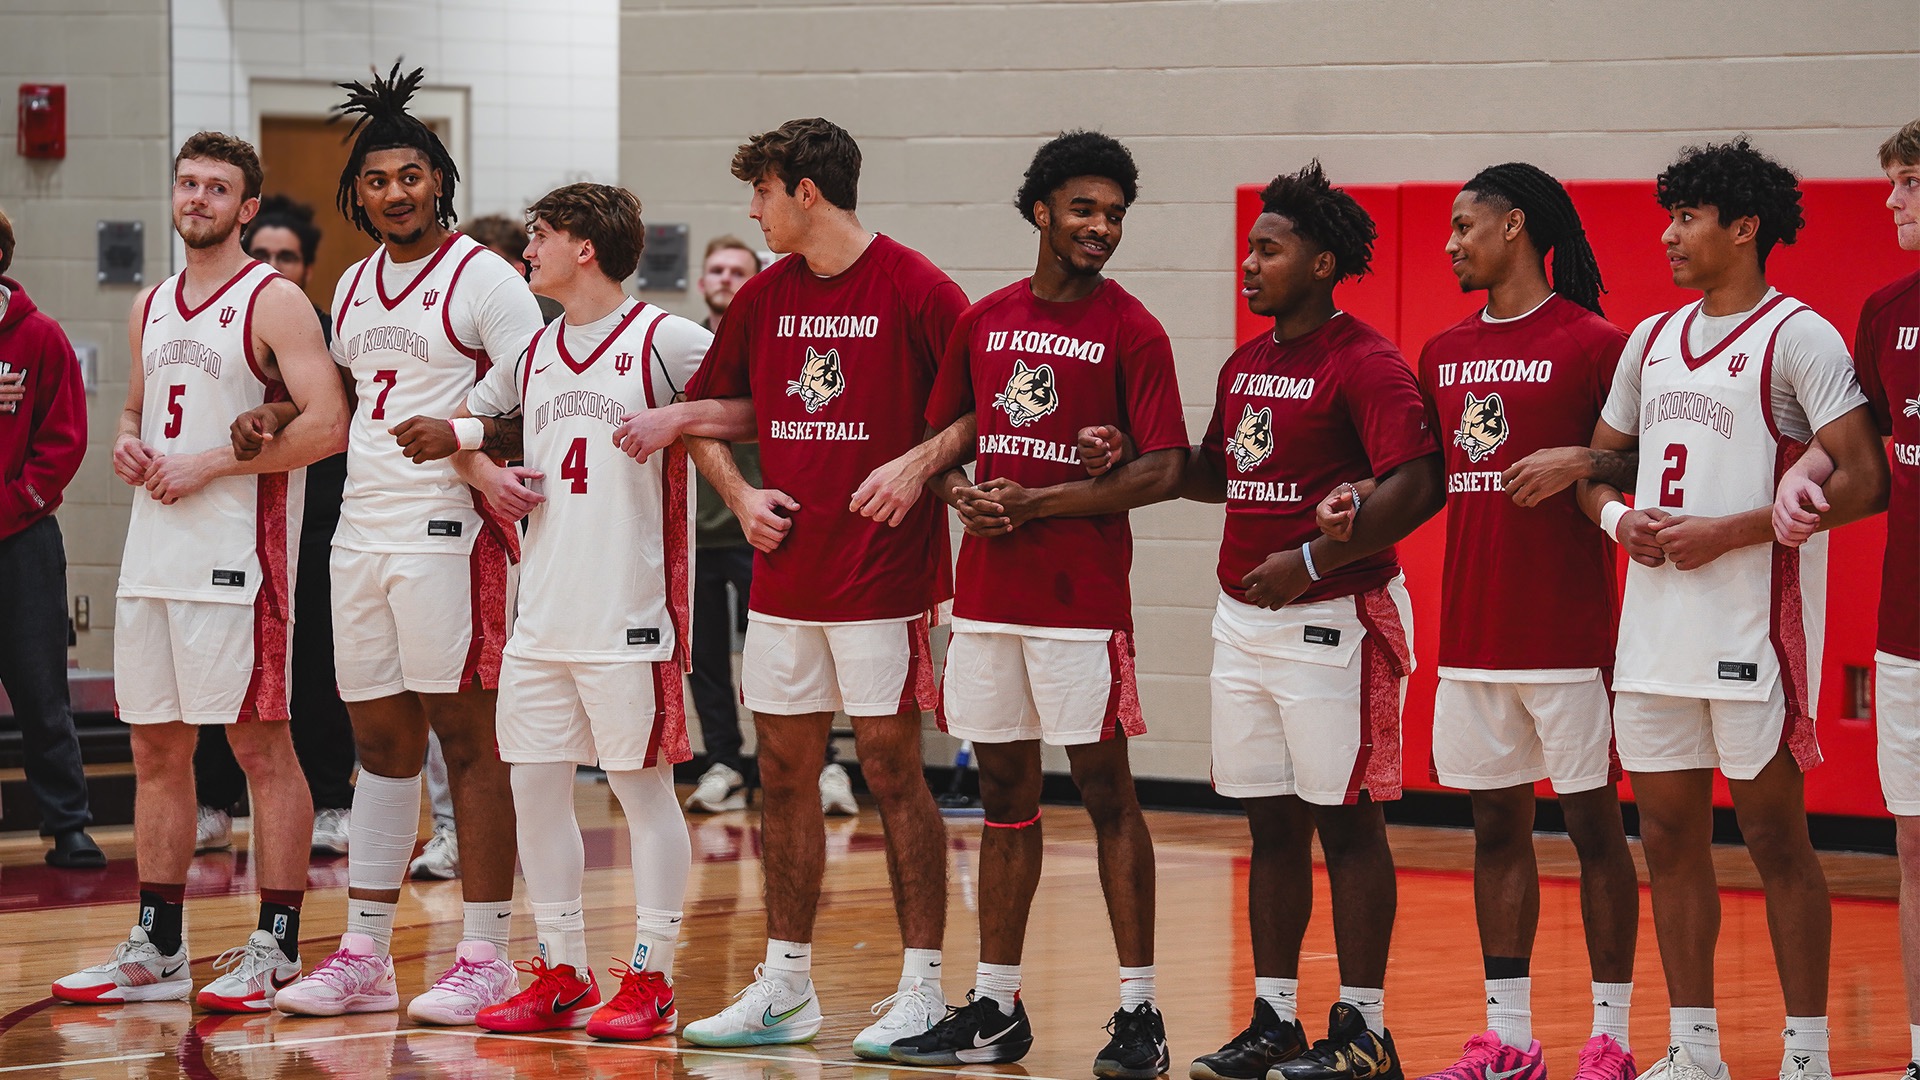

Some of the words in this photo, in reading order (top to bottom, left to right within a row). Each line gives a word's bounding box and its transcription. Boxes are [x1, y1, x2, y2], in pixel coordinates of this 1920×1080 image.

[362, 326, 429, 363] KOKOMO
[777, 315, 796, 337] IU
[798, 315, 879, 338] KOKOMO
[1896, 326, 1920, 350] IU
[158, 339, 222, 380] KOKOMO
[985, 331, 1008, 352] IU
[1009, 330, 1106, 365] KOKOMO
[1230, 372, 1249, 394] IU
[1243, 373, 1315, 400] KOKOMO
[1438, 362, 1457, 388] IU
[1459, 359, 1553, 383] KOKOMO
[164, 384, 187, 439] 5
[371, 370, 398, 420] 7
[535, 400, 550, 435] IU
[552, 390, 626, 430] KOKOMO
[771, 420, 870, 441] BASKETBALL
[1657, 391, 1734, 440] KOKOMO
[560, 437, 589, 494] 4
[1659, 443, 1689, 508] 2
